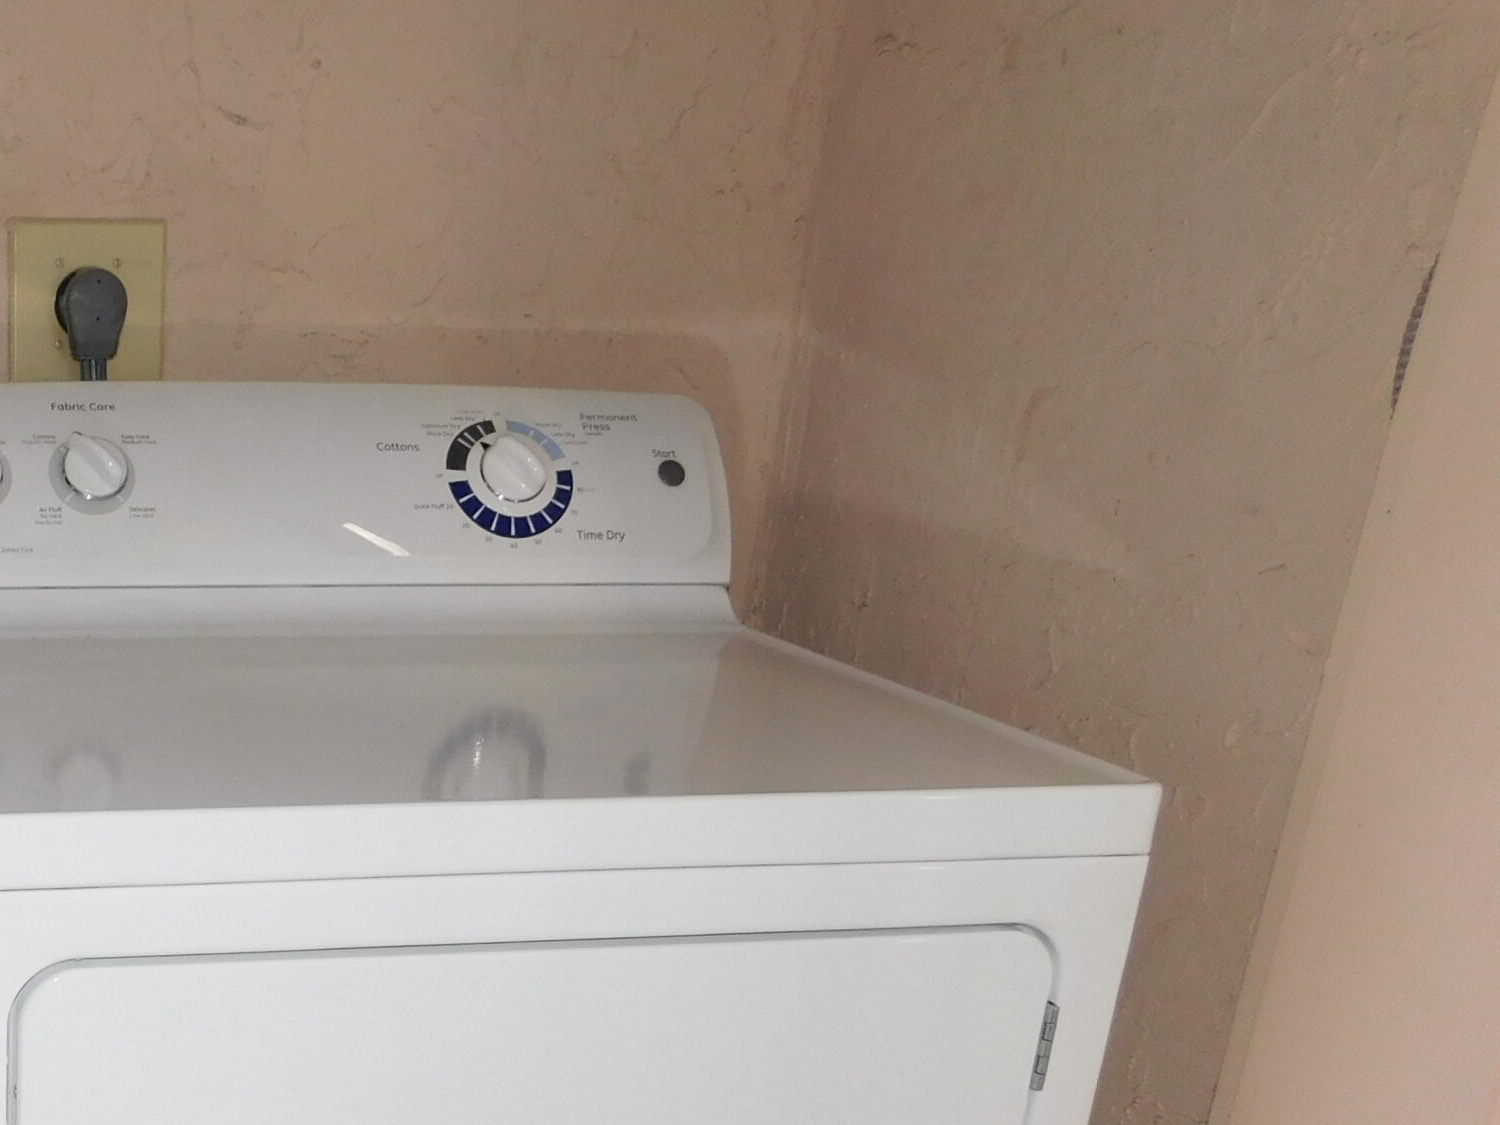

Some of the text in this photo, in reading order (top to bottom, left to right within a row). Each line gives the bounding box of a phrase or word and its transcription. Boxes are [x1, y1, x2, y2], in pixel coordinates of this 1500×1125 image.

[50, 402, 116, 411] Fabric Care
[579, 412, 638, 422] Permanent
[581, 422, 611, 431] Press
[376, 441, 420, 452] Cottons
[651, 449, 677, 459] Start
[576, 530, 626, 543] Time Dry
